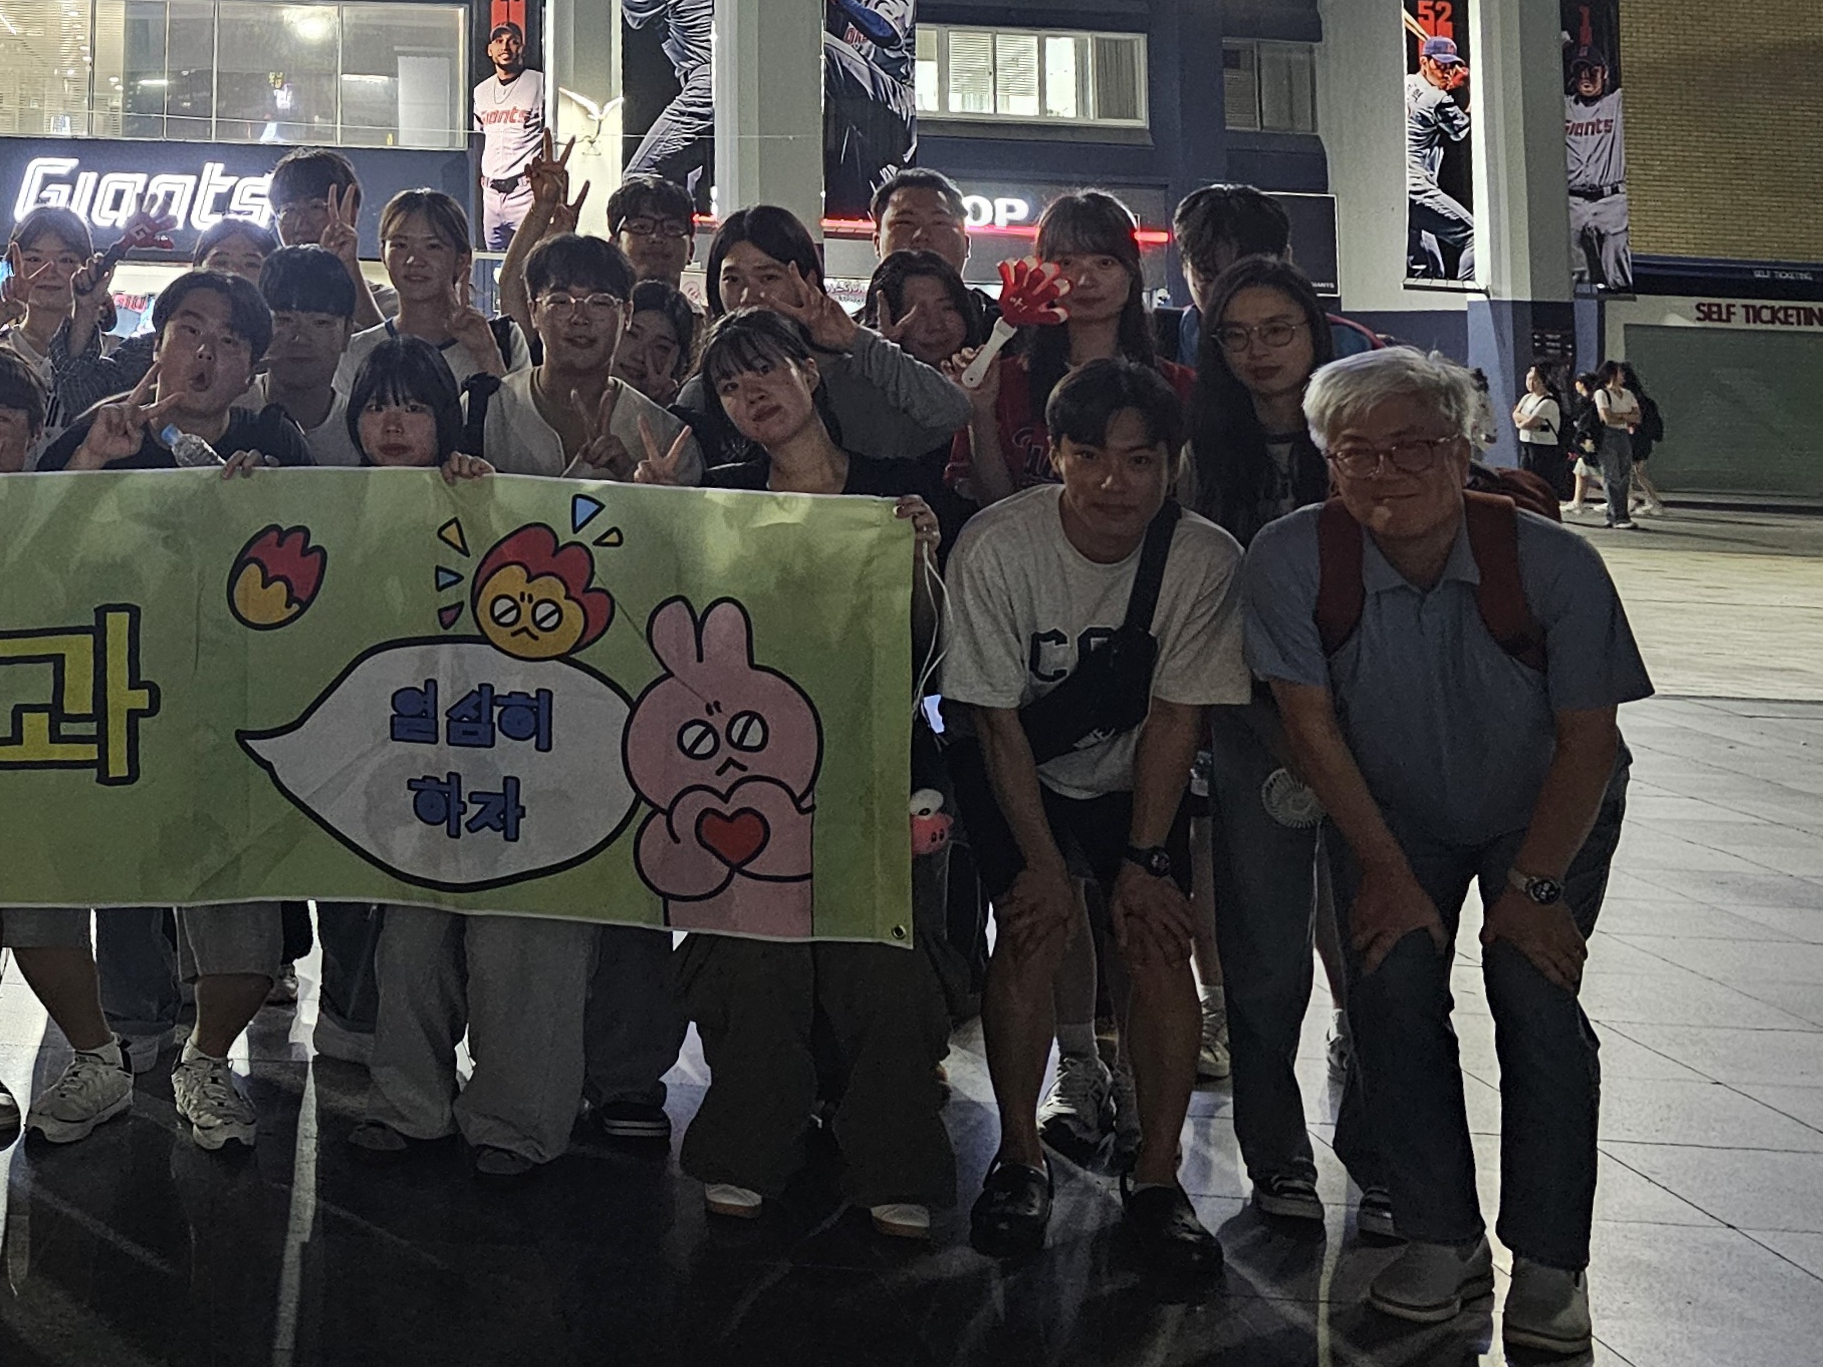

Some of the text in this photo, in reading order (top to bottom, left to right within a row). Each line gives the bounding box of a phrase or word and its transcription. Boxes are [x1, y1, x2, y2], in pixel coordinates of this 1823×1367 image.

[1417, 0, 1453, 23] 52
[14, 156, 273, 230] Giants
[963, 195, 1029, 228] OP
[1695, 303, 1737, 323] SELF
[390, 677, 554, 752] 열심히
[407, 771, 526, 842] 하자
